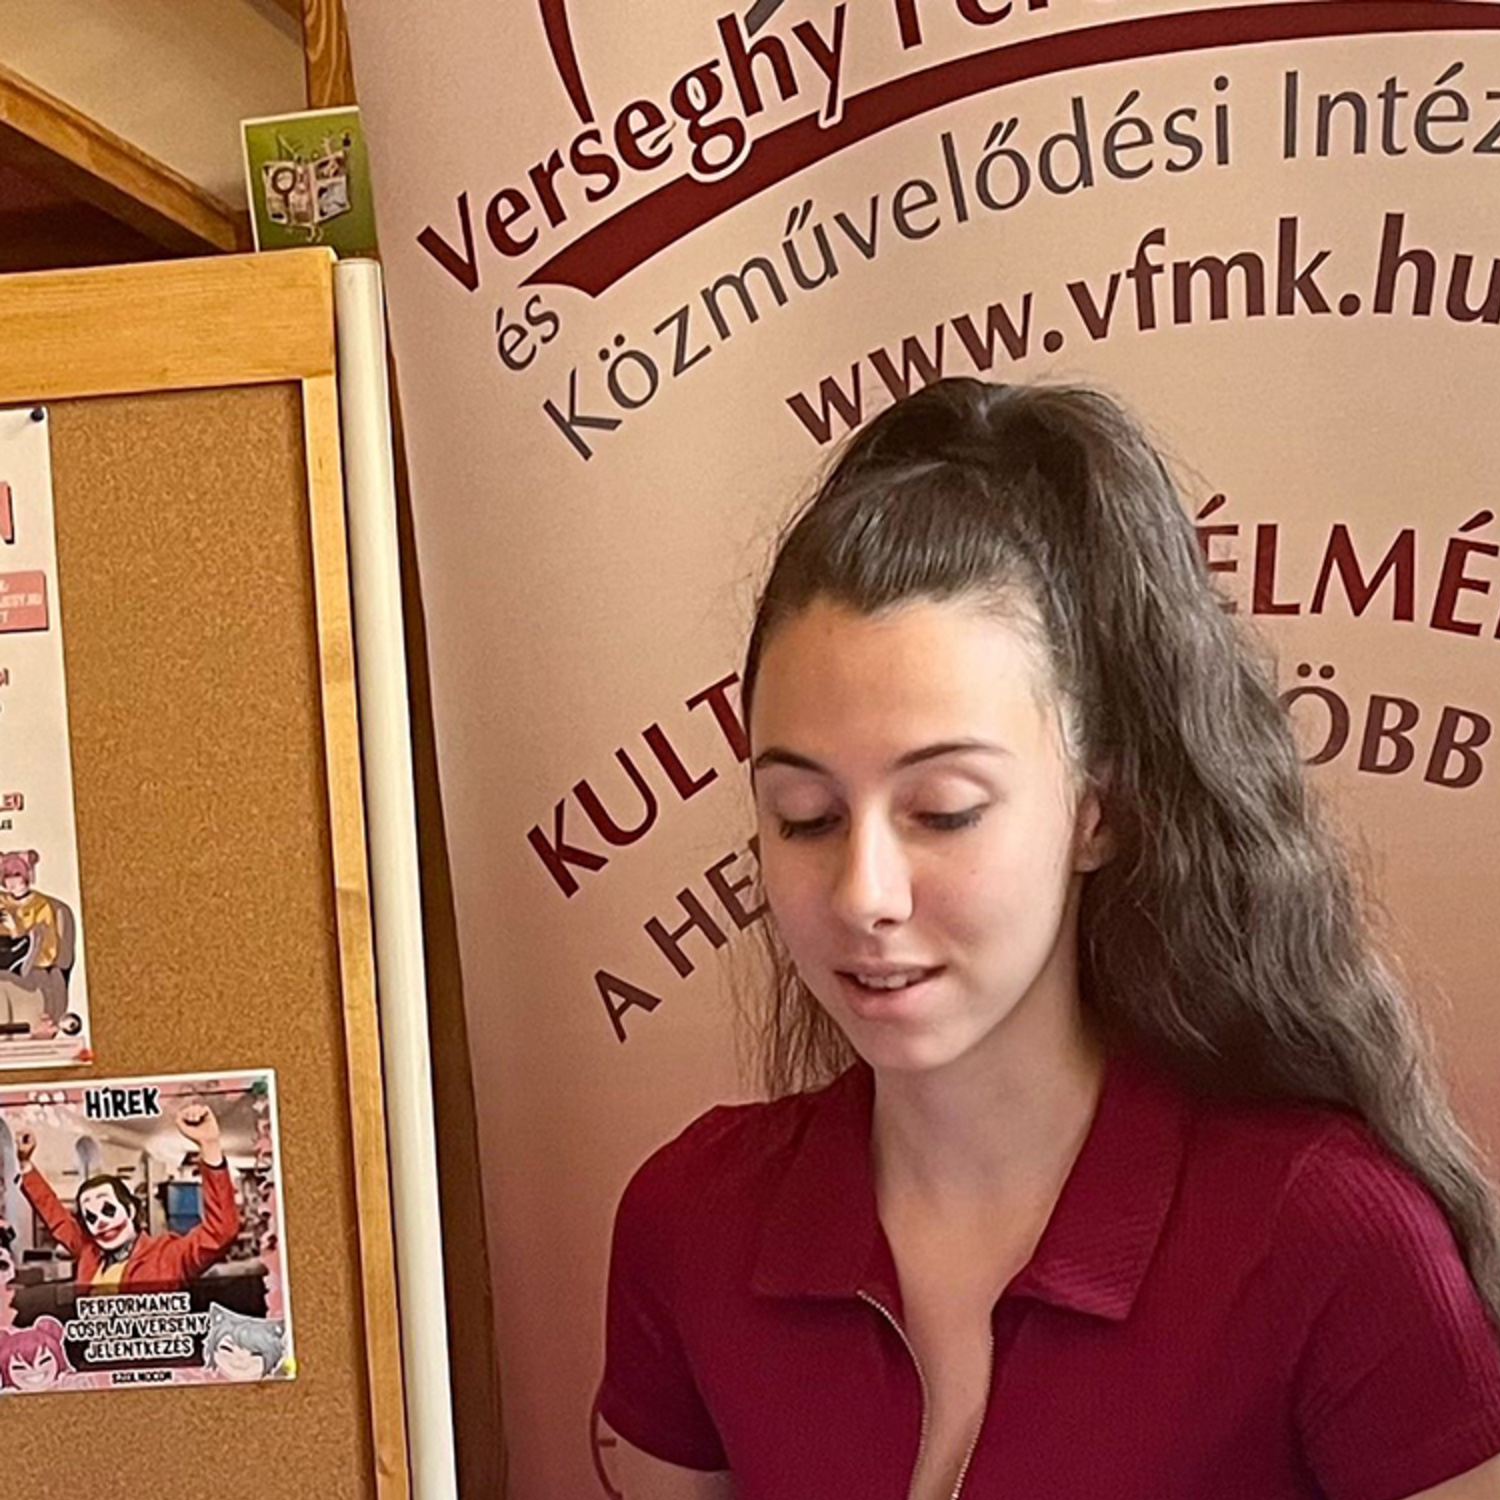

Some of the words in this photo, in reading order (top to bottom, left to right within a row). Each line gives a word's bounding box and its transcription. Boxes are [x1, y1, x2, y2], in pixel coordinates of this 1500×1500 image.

[416, 3, 847, 292] Verseghy
[497, 293, 560, 372] és
[542, 75, 1232, 461] Közművelődési
[526, 671, 752, 899] KULT
[594, 967, 662, 1043] A
[1280, 663, 1492, 789] ÖBB
[66, 1318, 137, 1340] COSPLAY
[137, 1315, 210, 1334] VERSENY
[76, 1293, 191, 1317] PERFORMANCE
[85, 1338, 194, 1361] JELENTKEZÉS
